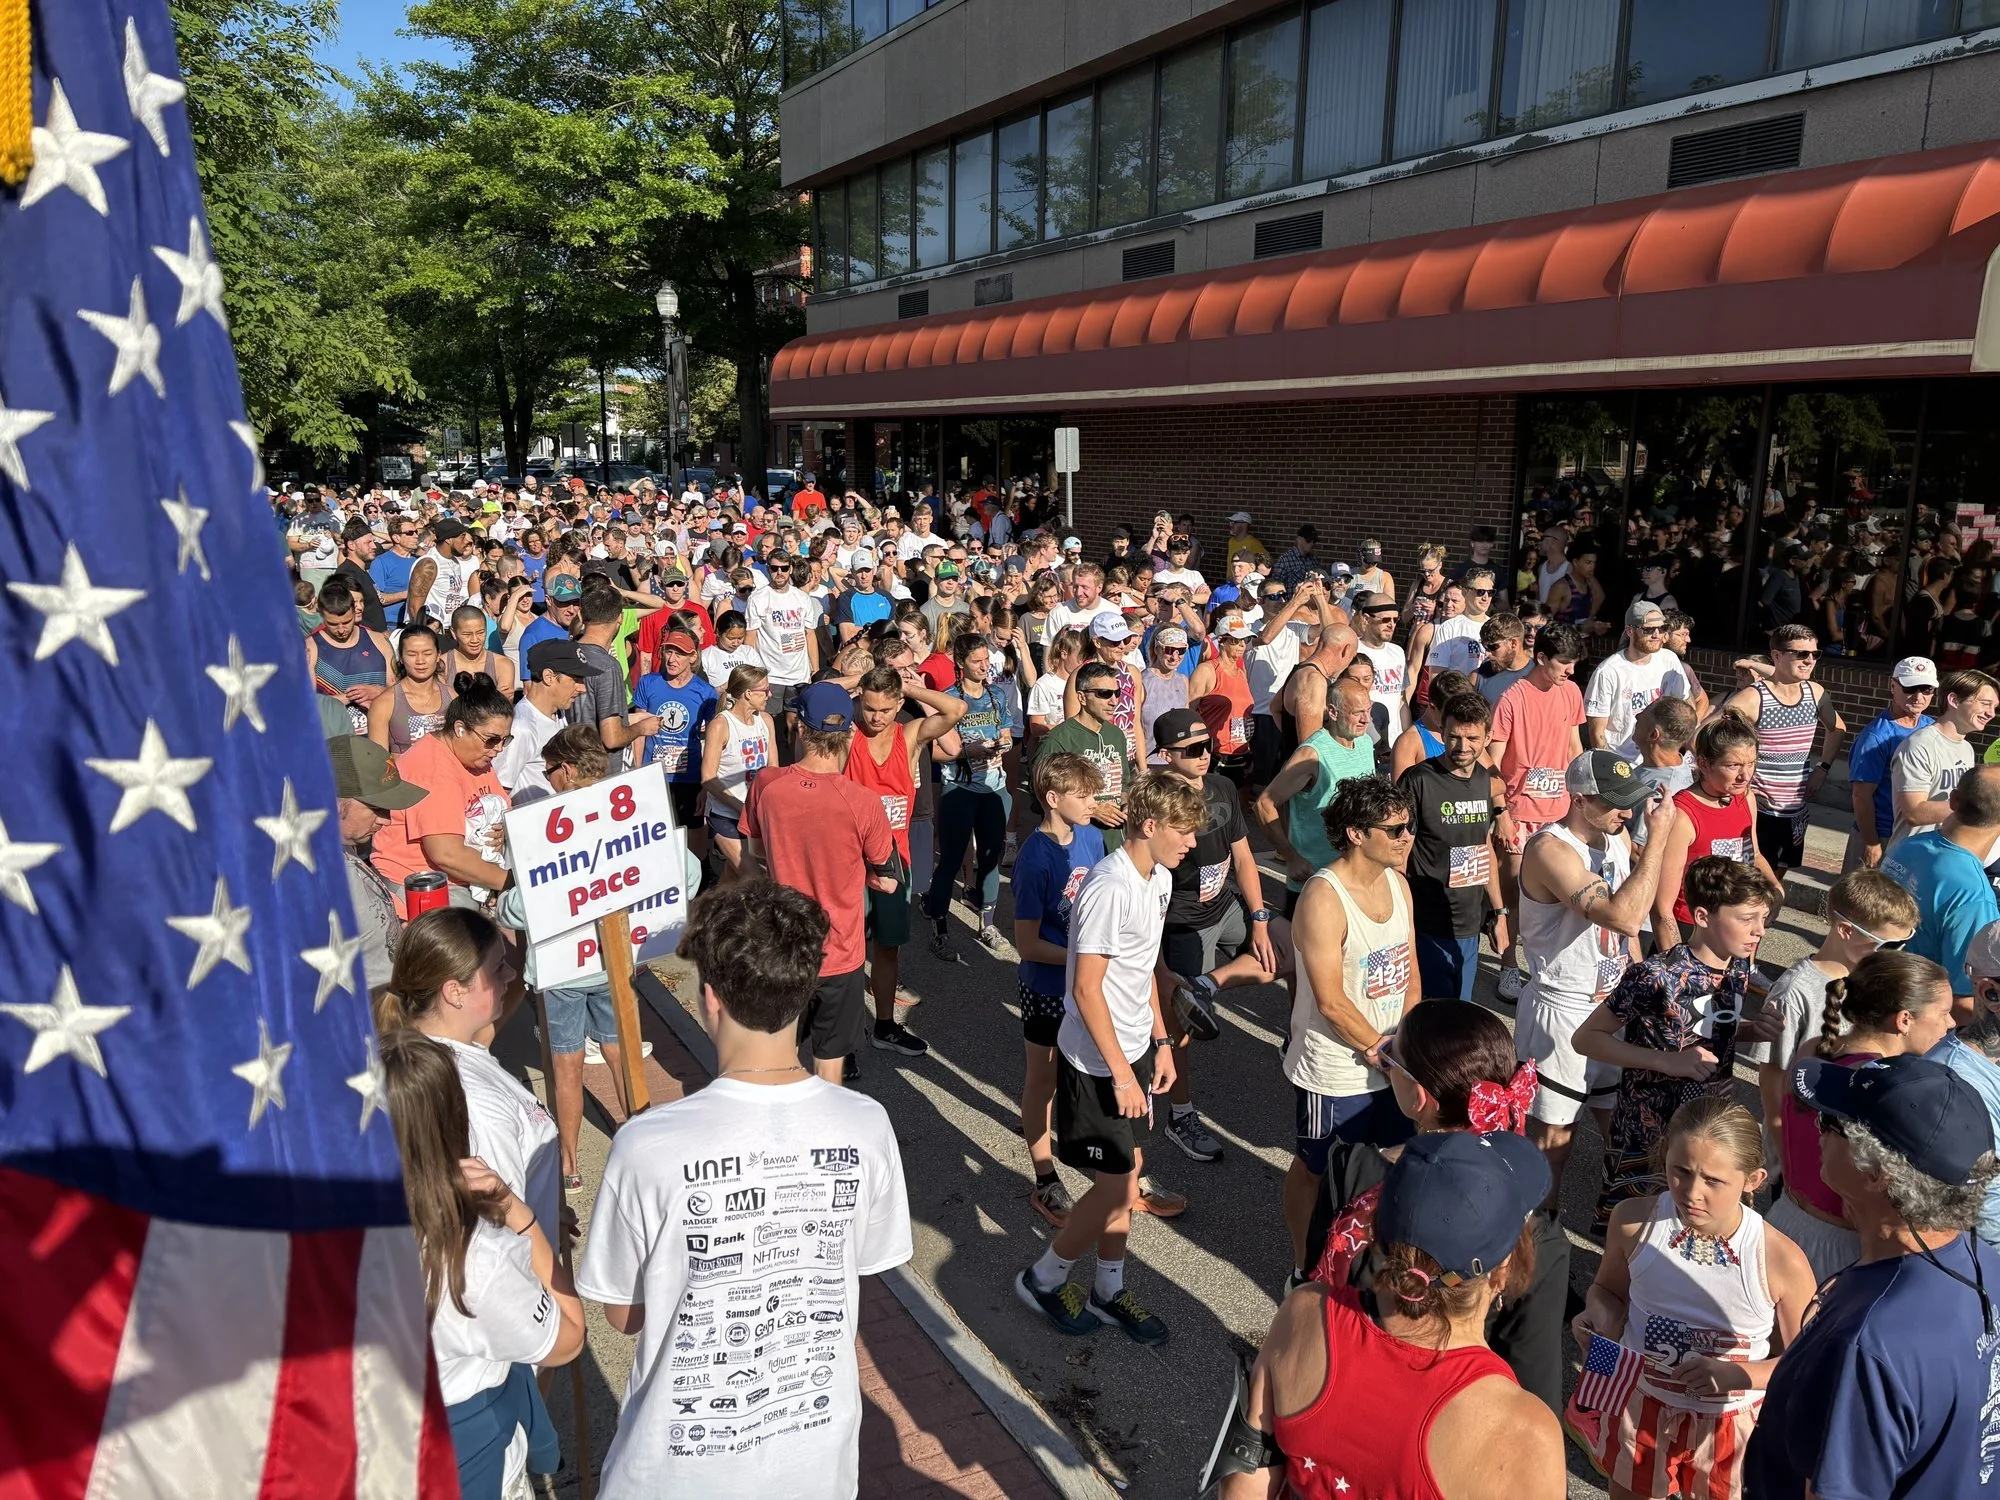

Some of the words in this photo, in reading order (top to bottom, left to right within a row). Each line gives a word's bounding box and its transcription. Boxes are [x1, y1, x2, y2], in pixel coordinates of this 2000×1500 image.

[745, 754, 765, 769] CA
[545, 805, 574, 844] 6
[609, 785, 637, 822] 8
[529, 821, 667, 888] min/mile
[568, 865, 641, 917] pace
[1796, 1068, 1815, 1099] VETERAN
[810, 1144, 859, 1167] TED'S
[1087, 1146, 1103, 1160] 78
[763, 1155, 798, 1166] BAYADA
[683, 1155, 741, 1183] UNFI
[774, 1191, 801, 1200] Frazier
[811, 1188, 827, 1198] Son
[835, 1182, 857, 1194] 103.7
[726, 1189, 765, 1211] AMT
[682, 1217, 718, 1226] BADGER
[724, 1210, 765, 1222] PRODUCTIONS
[820, 1217, 854, 1228] SAFETY
[688, 1237, 707, 1250] TD
[713, 1232, 746, 1247] Bank
[762, 1229, 783, 1240] LUXURY
[753, 1246, 800, 1266] NHTrust
[752, 1264, 774, 1274] FINANCIAL
[774, 1259, 798, 1268] ADVISORS
[769, 1275, 803, 1289] PARAGON
[727, 1287, 762, 1296] DEALERSHIPS
[725, 1306, 761, 1319] Samson
[677, 1353, 709, 1364] Norm's
[686, 1373, 711, 1385] DAR
[777, 1372, 796, 1383] KENDALL
[797, 1369, 809, 1379] LANE
[709, 1398, 737, 1409] GFA
